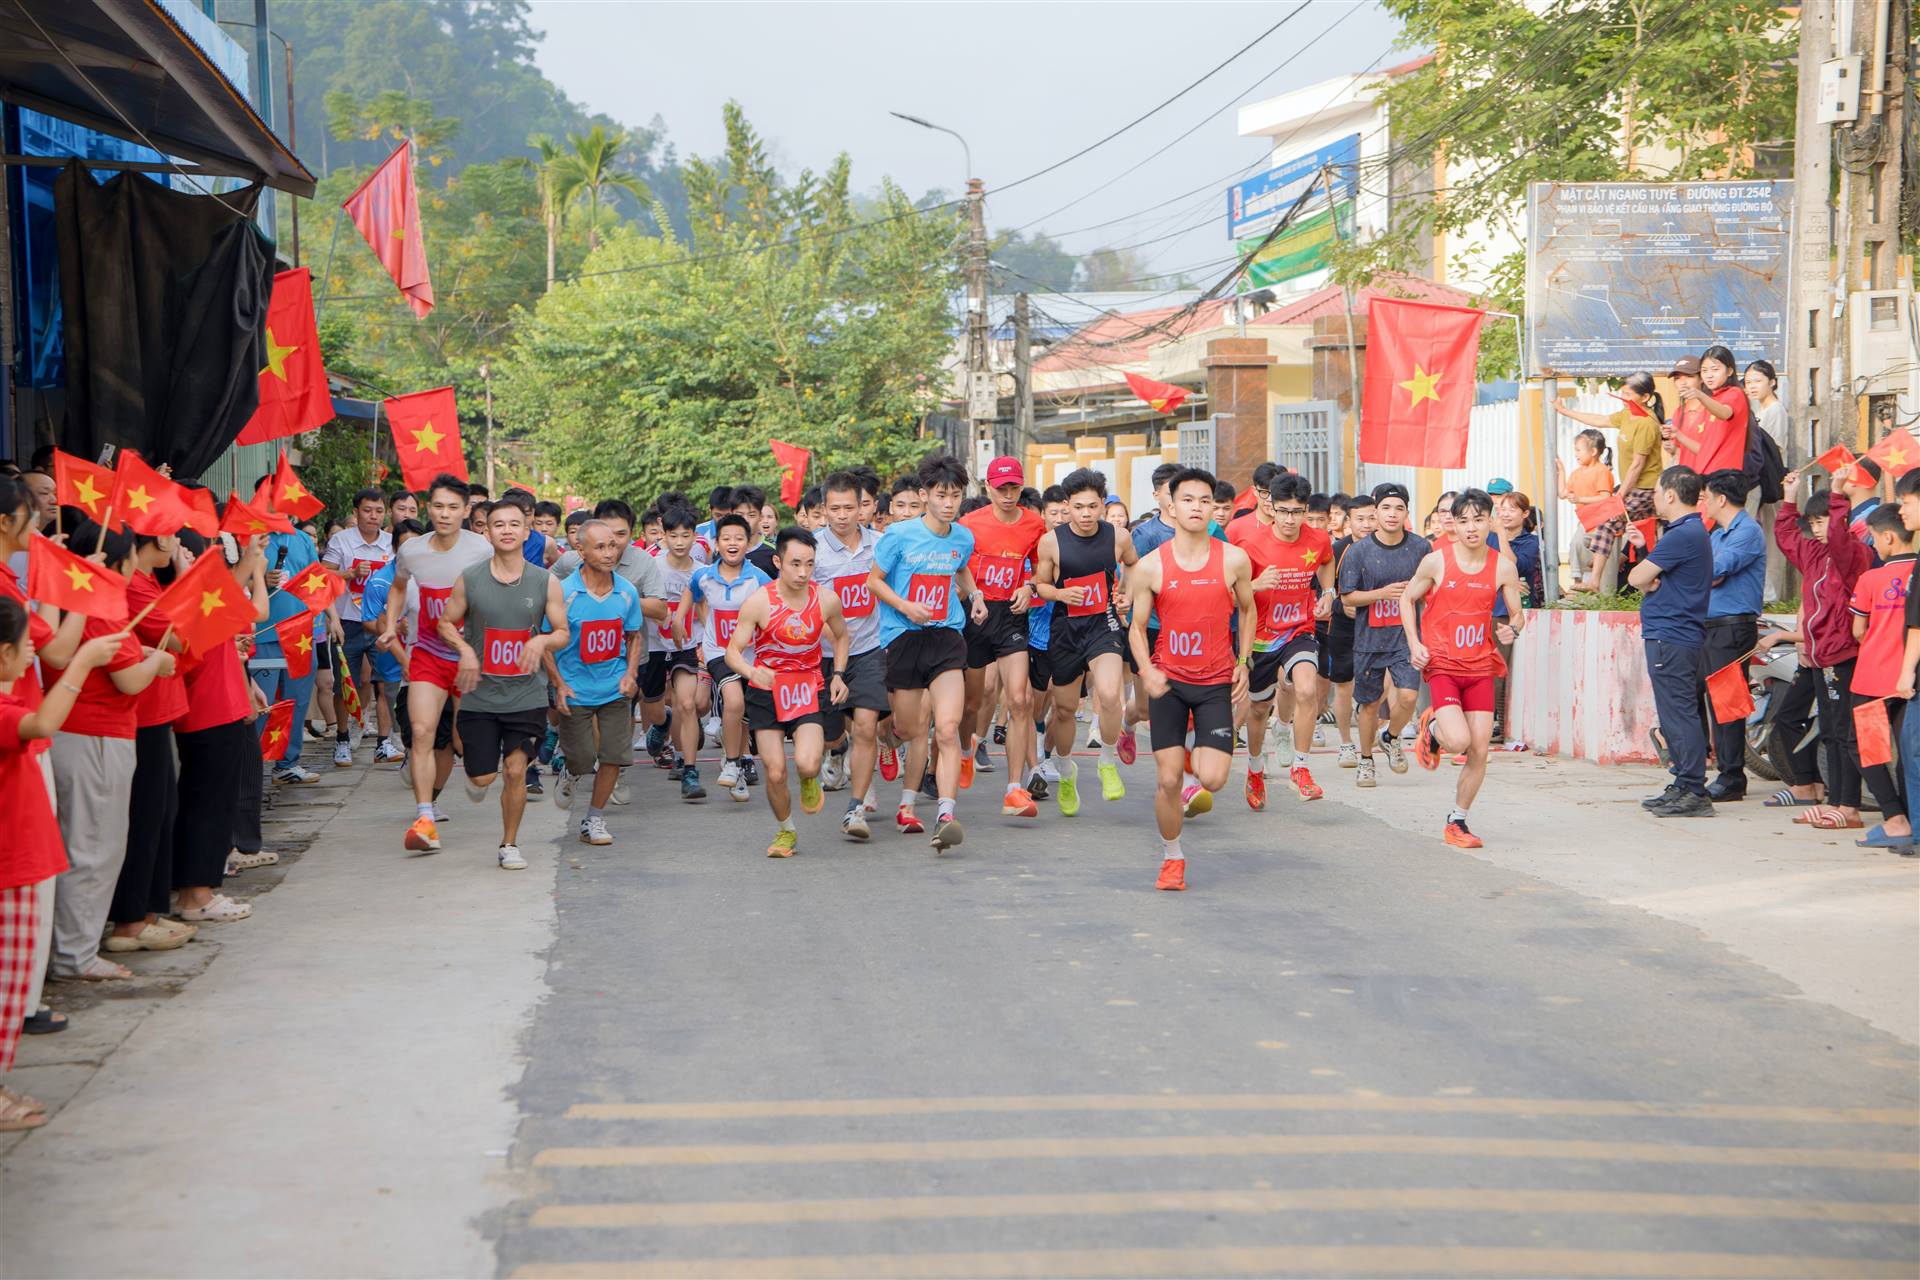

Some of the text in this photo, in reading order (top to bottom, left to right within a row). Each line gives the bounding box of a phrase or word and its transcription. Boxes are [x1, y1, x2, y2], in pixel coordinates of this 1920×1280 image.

[1609, 188, 1647, 201] NGANG
[1687, 185, 1726, 200] ĐƯỜNG
[985, 564, 1014, 589] 043
[841, 582, 870, 609] 029
[915, 584, 945, 610] 042
[1273, 602, 1301, 624] 005
[1375, 599, 1399, 619] 038
[587, 629, 616, 653] 030
[1169, 629, 1203, 656] 002
[1455, 623, 1485, 648] 004
[491, 639, 524, 666] 060
[780, 681, 812, 710] 040
